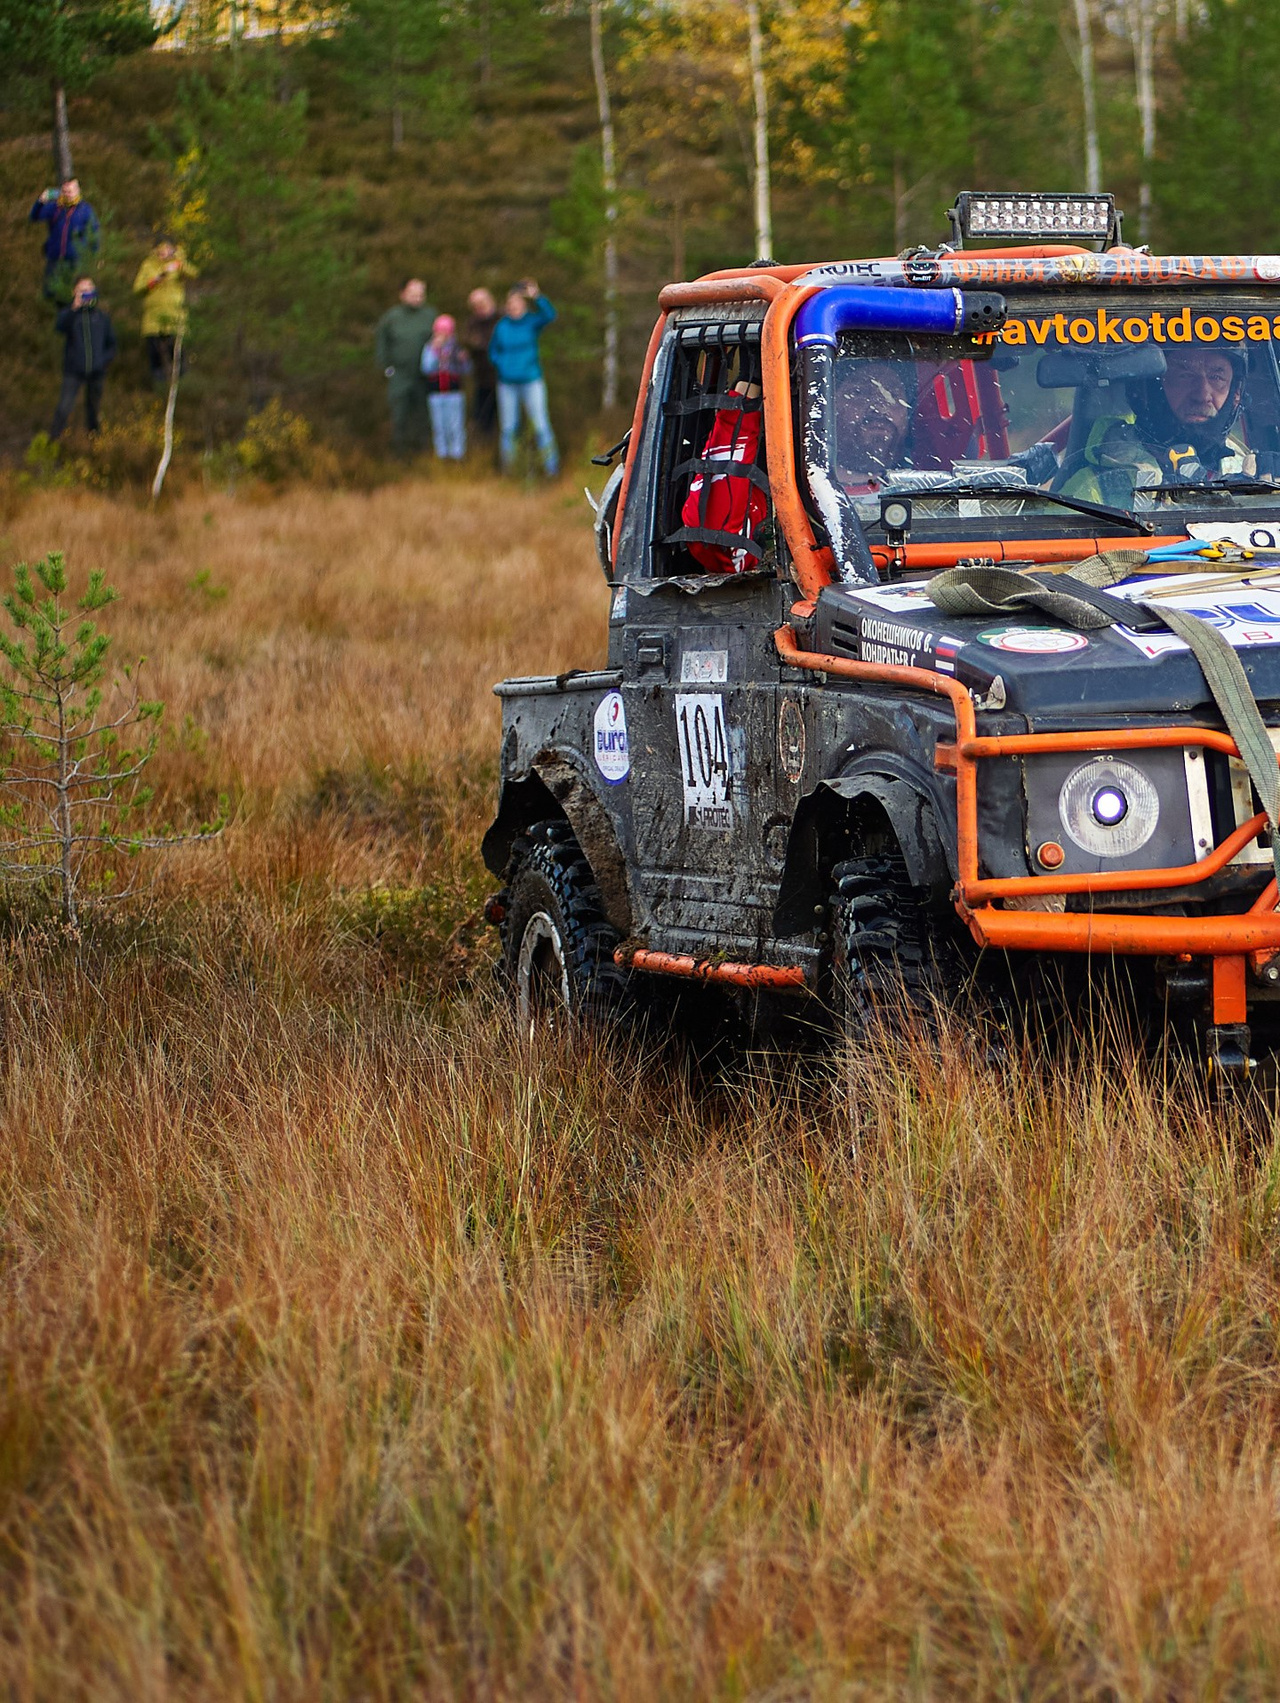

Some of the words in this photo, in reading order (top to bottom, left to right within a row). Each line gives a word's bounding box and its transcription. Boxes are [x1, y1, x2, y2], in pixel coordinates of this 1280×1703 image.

[861, 617, 924, 651] ОКОНЕШНИКОВ
[923, 633, 933, 654] В.
[861, 640, 908, 667] КОНДРАТЬЕВ
[680, 704, 728, 788] 104
